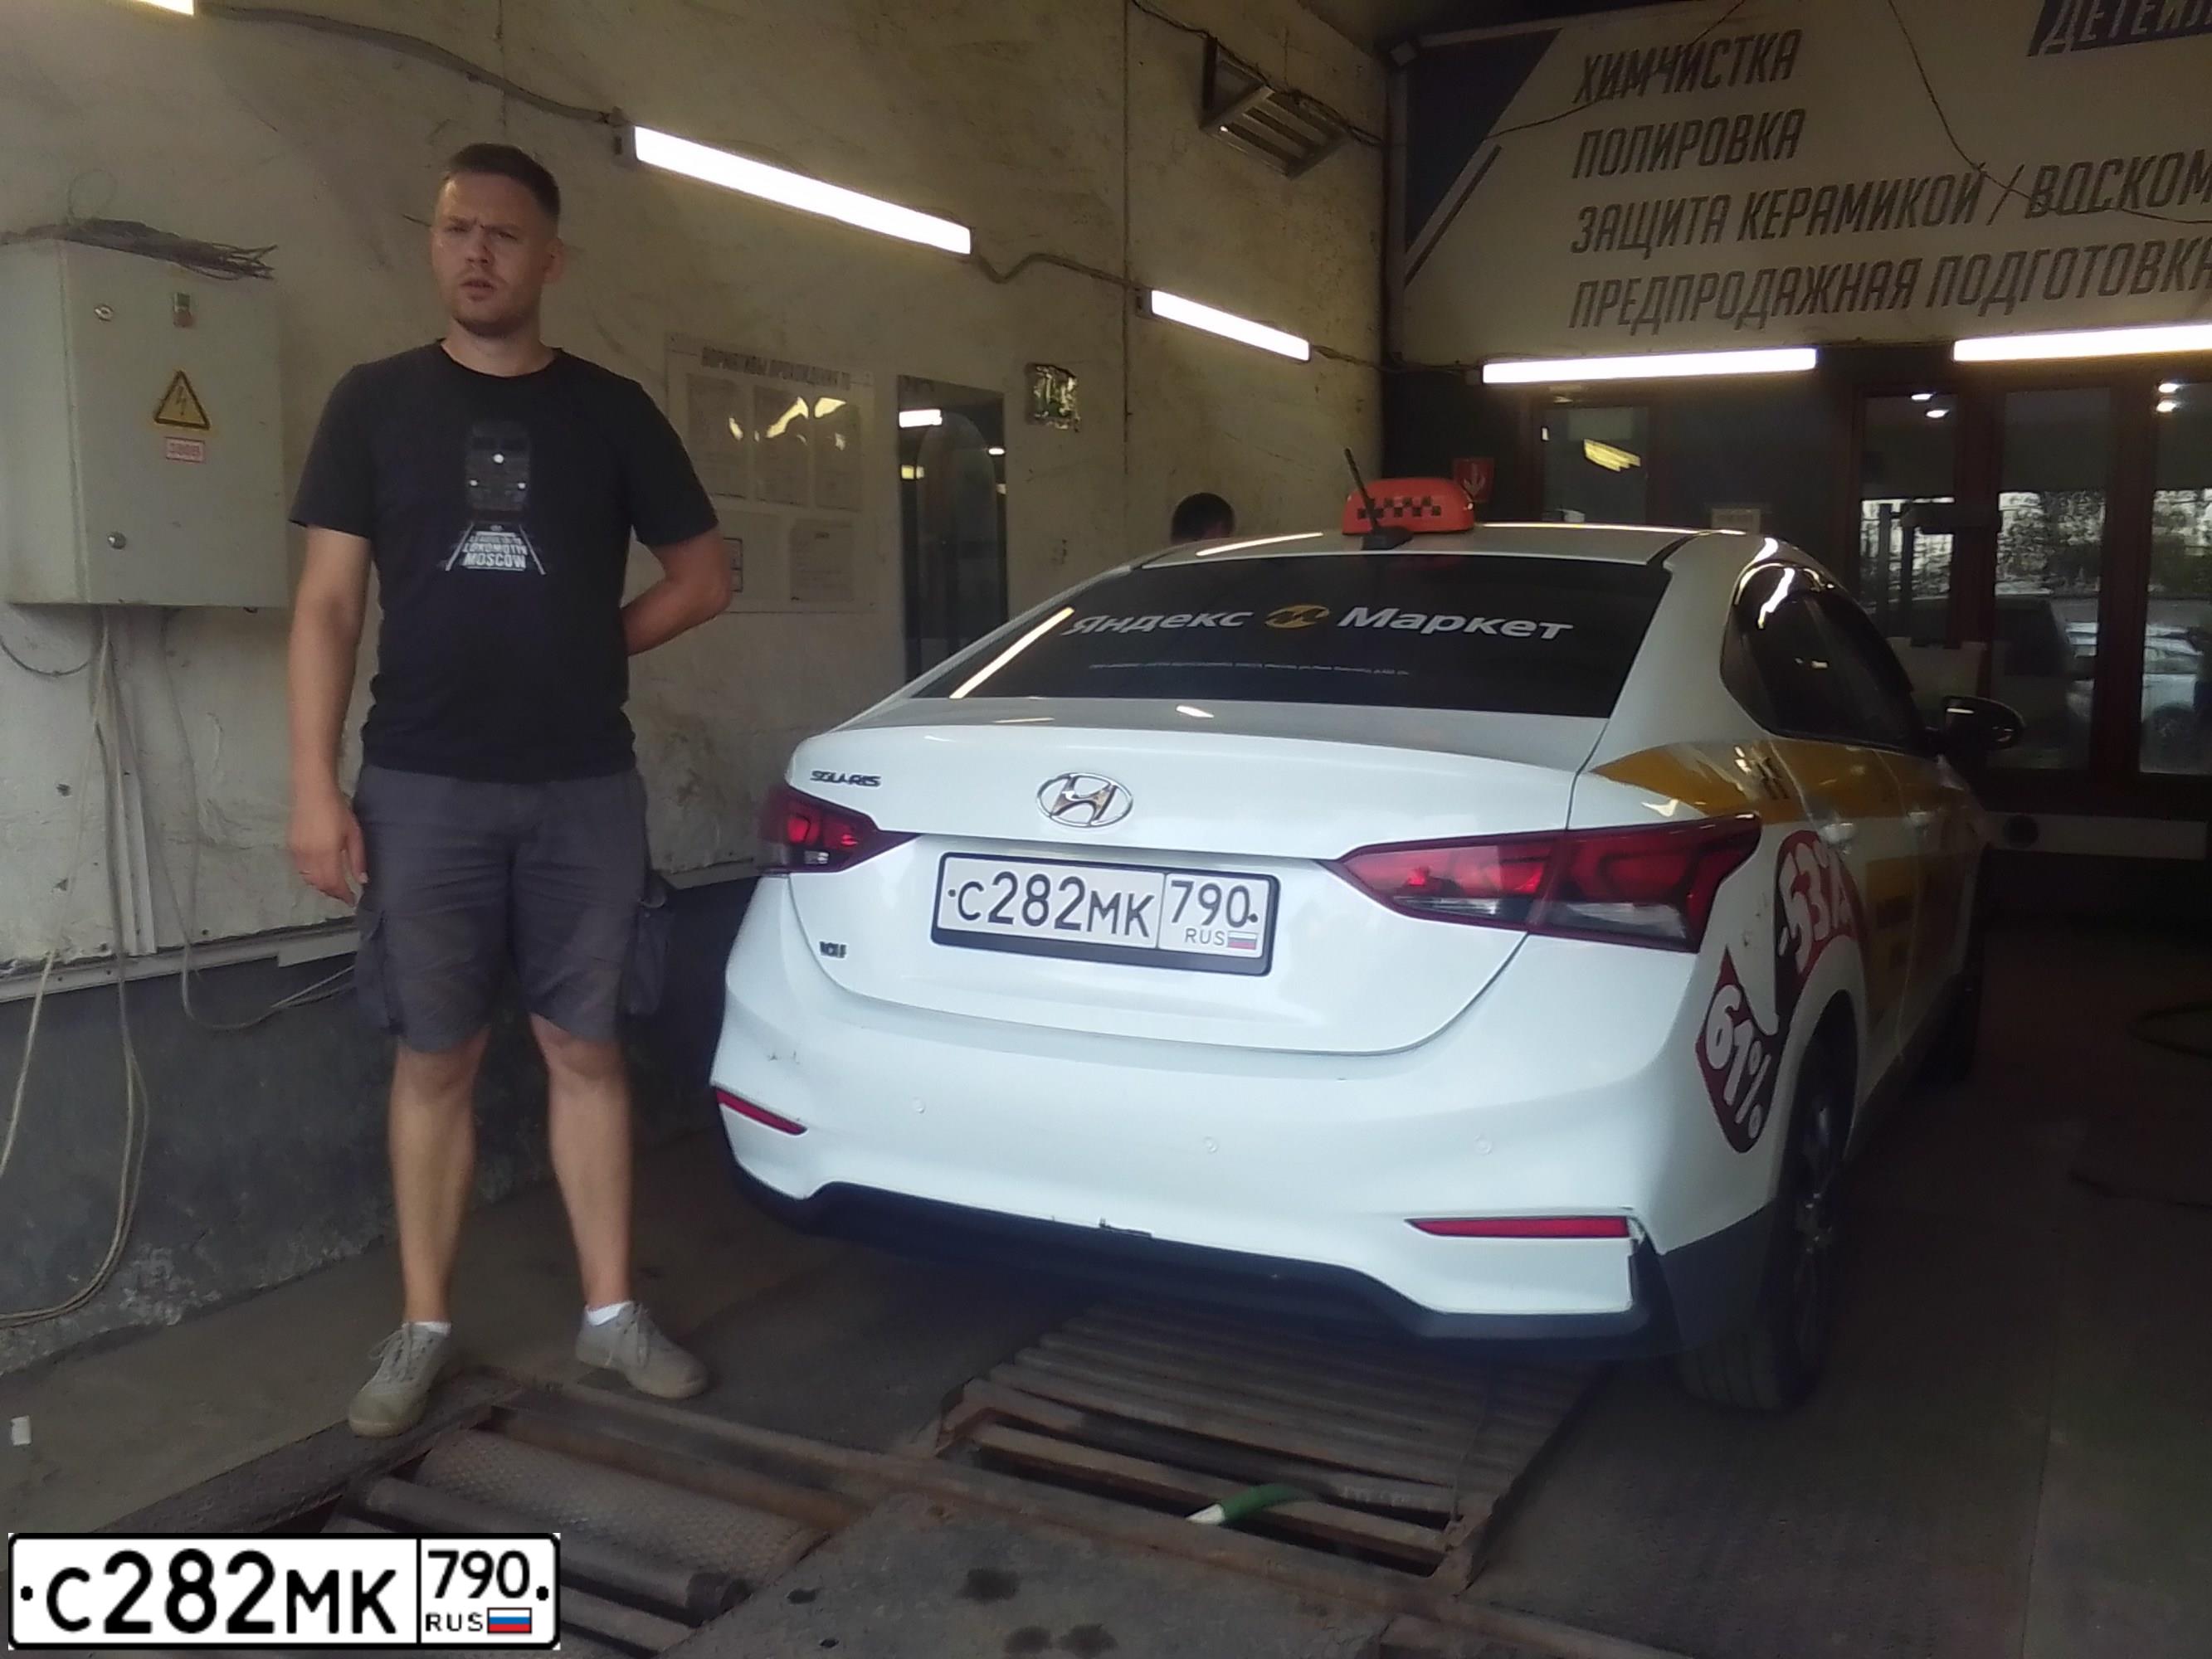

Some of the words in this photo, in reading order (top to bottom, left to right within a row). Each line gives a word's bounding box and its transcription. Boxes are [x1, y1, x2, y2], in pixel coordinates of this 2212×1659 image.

[1571, 28, 1804, 104] ХИМЧИСТКА
[1571, 108, 1806, 179] ПОЛИРОВКА
[1570, 193, 1732, 261] ЗАЩИТА
[1737, 161, 1988, 243] КЕРАМИКОЙ
[1986, 164, 2025, 227] /
[2024, 148, 2212, 220] ВОСКОМ
[1568, 257, 1923, 337] ПРЕДПРОДАЖНАЯ
[1925, 236, 2212, 319] ПОДГОТОВКА
[462, 552, 527, 568] MOSCOW
[1060, 611, 1255, 636] Яндекс
[1337, 606, 1575, 640] Маркет
[1170, 879, 1251, 928] 790
[1184, 927, 1225, 946] RUS
